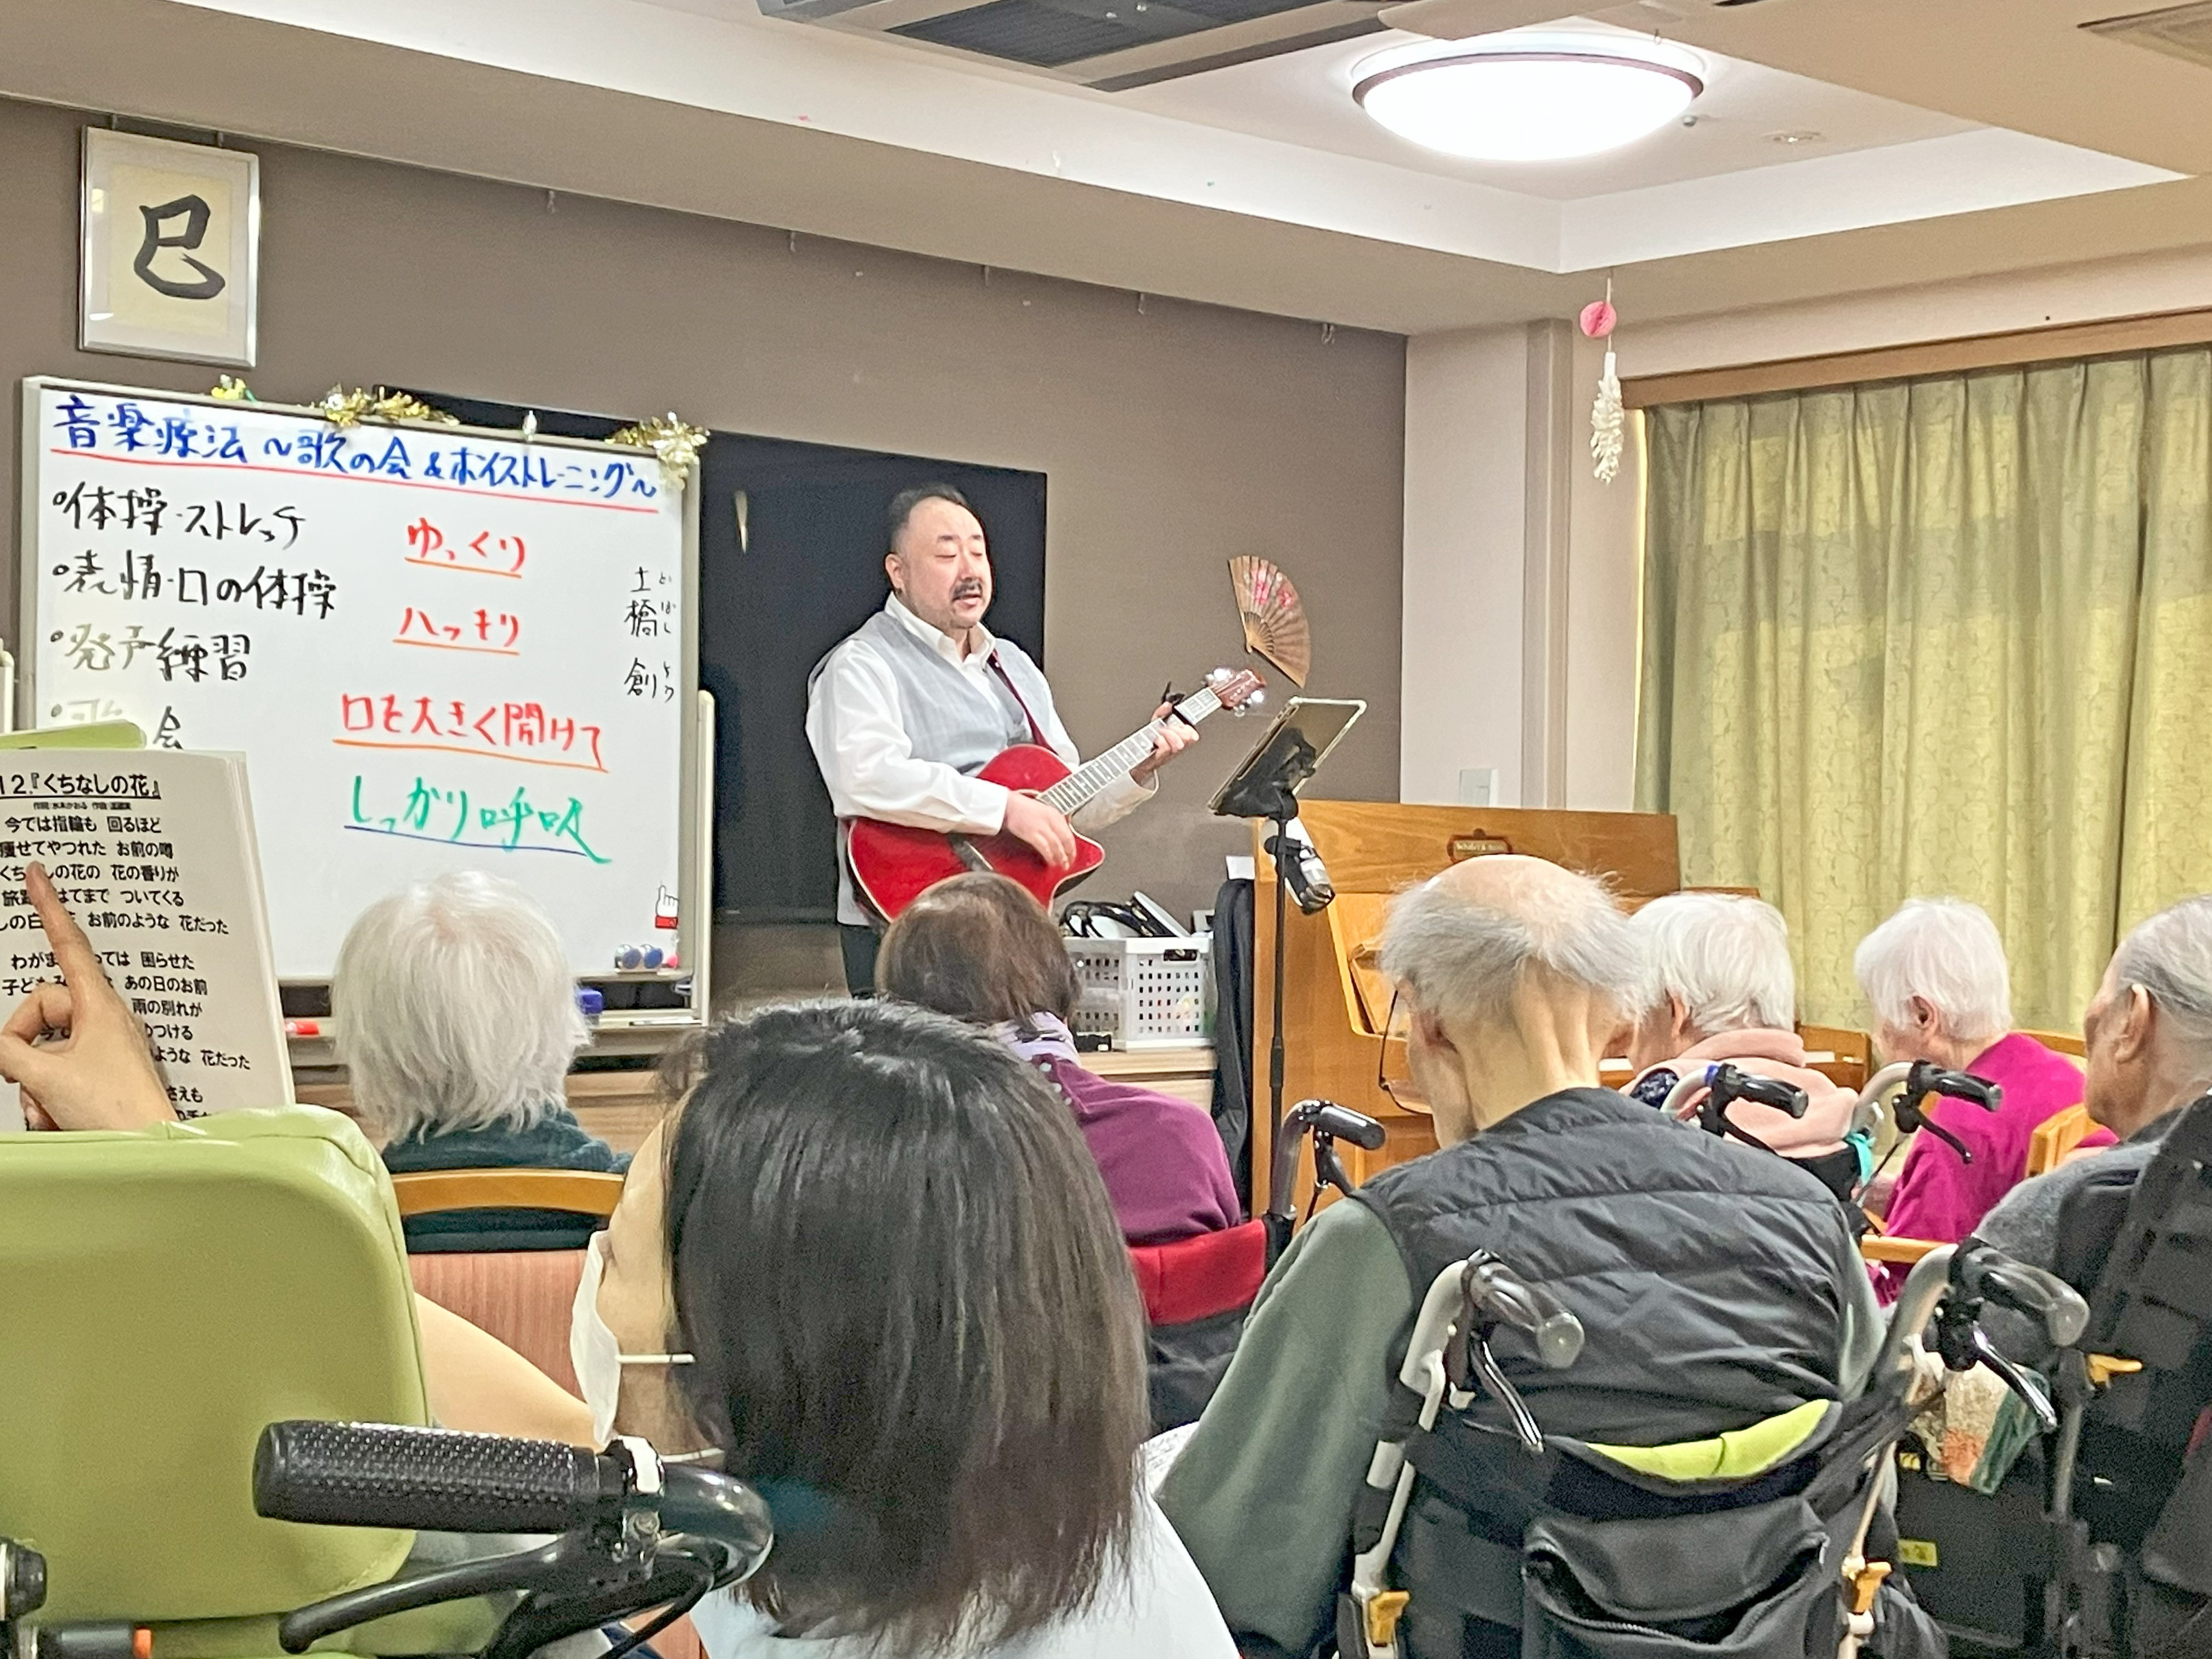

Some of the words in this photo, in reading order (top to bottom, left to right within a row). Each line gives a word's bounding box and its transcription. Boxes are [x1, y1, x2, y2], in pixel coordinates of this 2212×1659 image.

[134, 194, 225, 299] 巳
[408, 517, 526, 572] ゆっくり
[399, 607, 519, 647] ハッキリ
[342, 693, 603, 770] 口を大きく開けて
[5, 815, 97, 833] 今では指輪も
[107, 816, 161, 833] 回るほど
[353, 775, 613, 865] しっかり呼吸
[0, 863, 100, 881] くちの花の
[110, 864, 179, 882] 花の香りが
[120, 889, 184, 906] ついてくる
[88, 911, 170, 929] お前のような
[179, 915, 229, 934] 花だった
[140, 951, 195, 970] 困らせた
[125, 975, 208, 996] あの日のお前
[131, 997, 203, 1018] 雨の別れが
[150, 1046, 191, 1064] ような
[200, 1049, 251, 1070] 花だった
